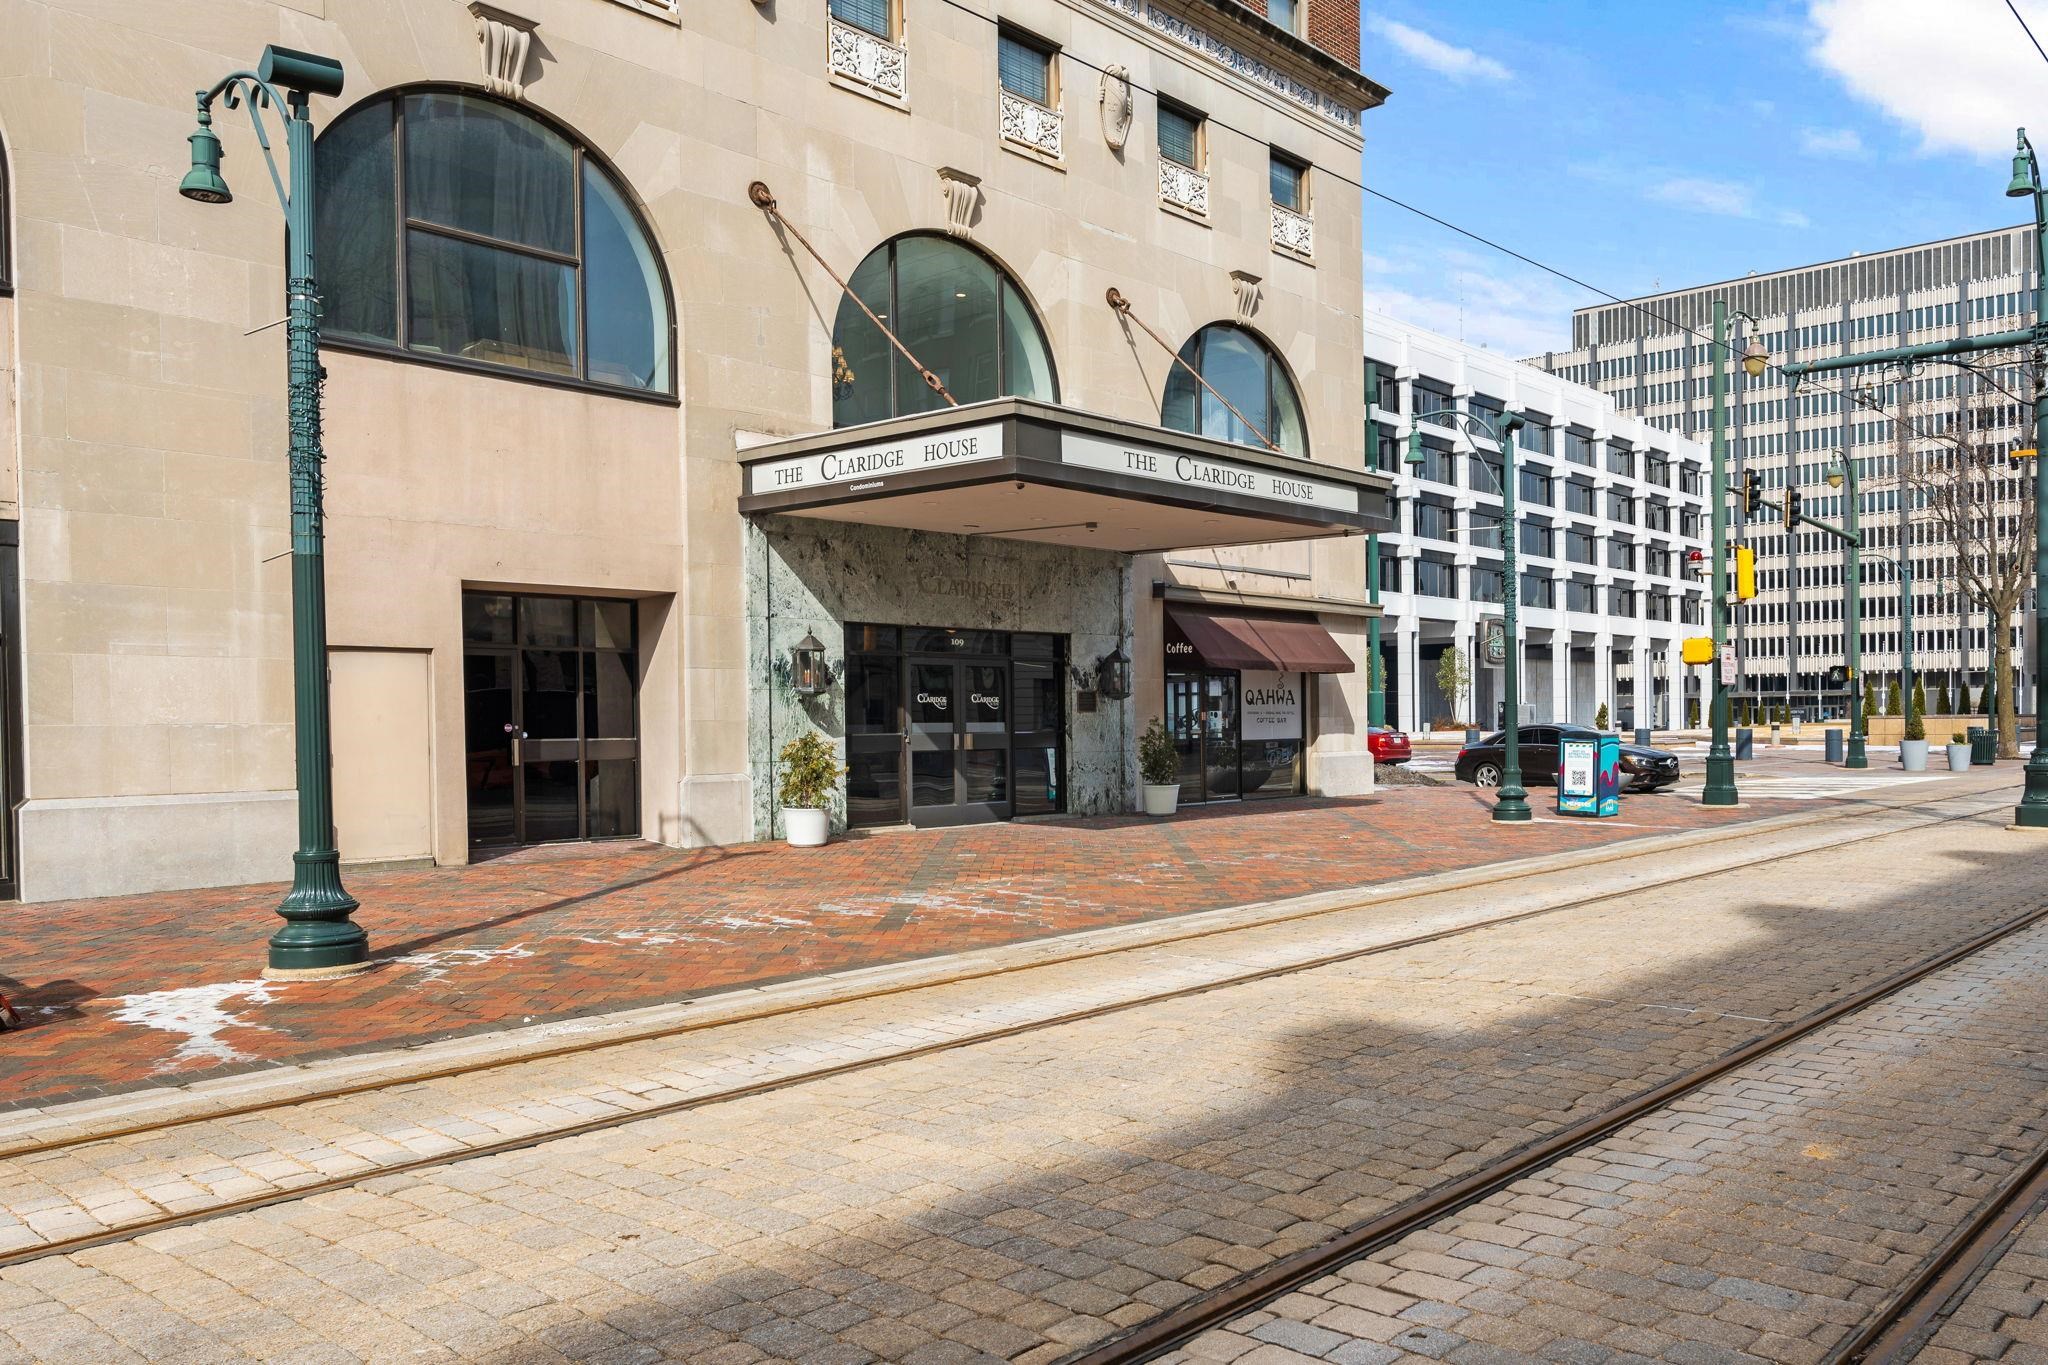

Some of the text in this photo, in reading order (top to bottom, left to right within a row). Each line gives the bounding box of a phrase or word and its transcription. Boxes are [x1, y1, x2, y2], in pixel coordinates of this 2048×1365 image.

[774, 437, 978, 485] THE CLARIDGE HOUSE
[1124, 451, 1314, 500] THE CLARIDGE HOUSE
[849, 481, 884, 491] Condominiums
[951, 638, 965, 646] 109
[1166, 642, 1193, 654] Coffee
[1245, 688, 1295, 706] QAHWA
